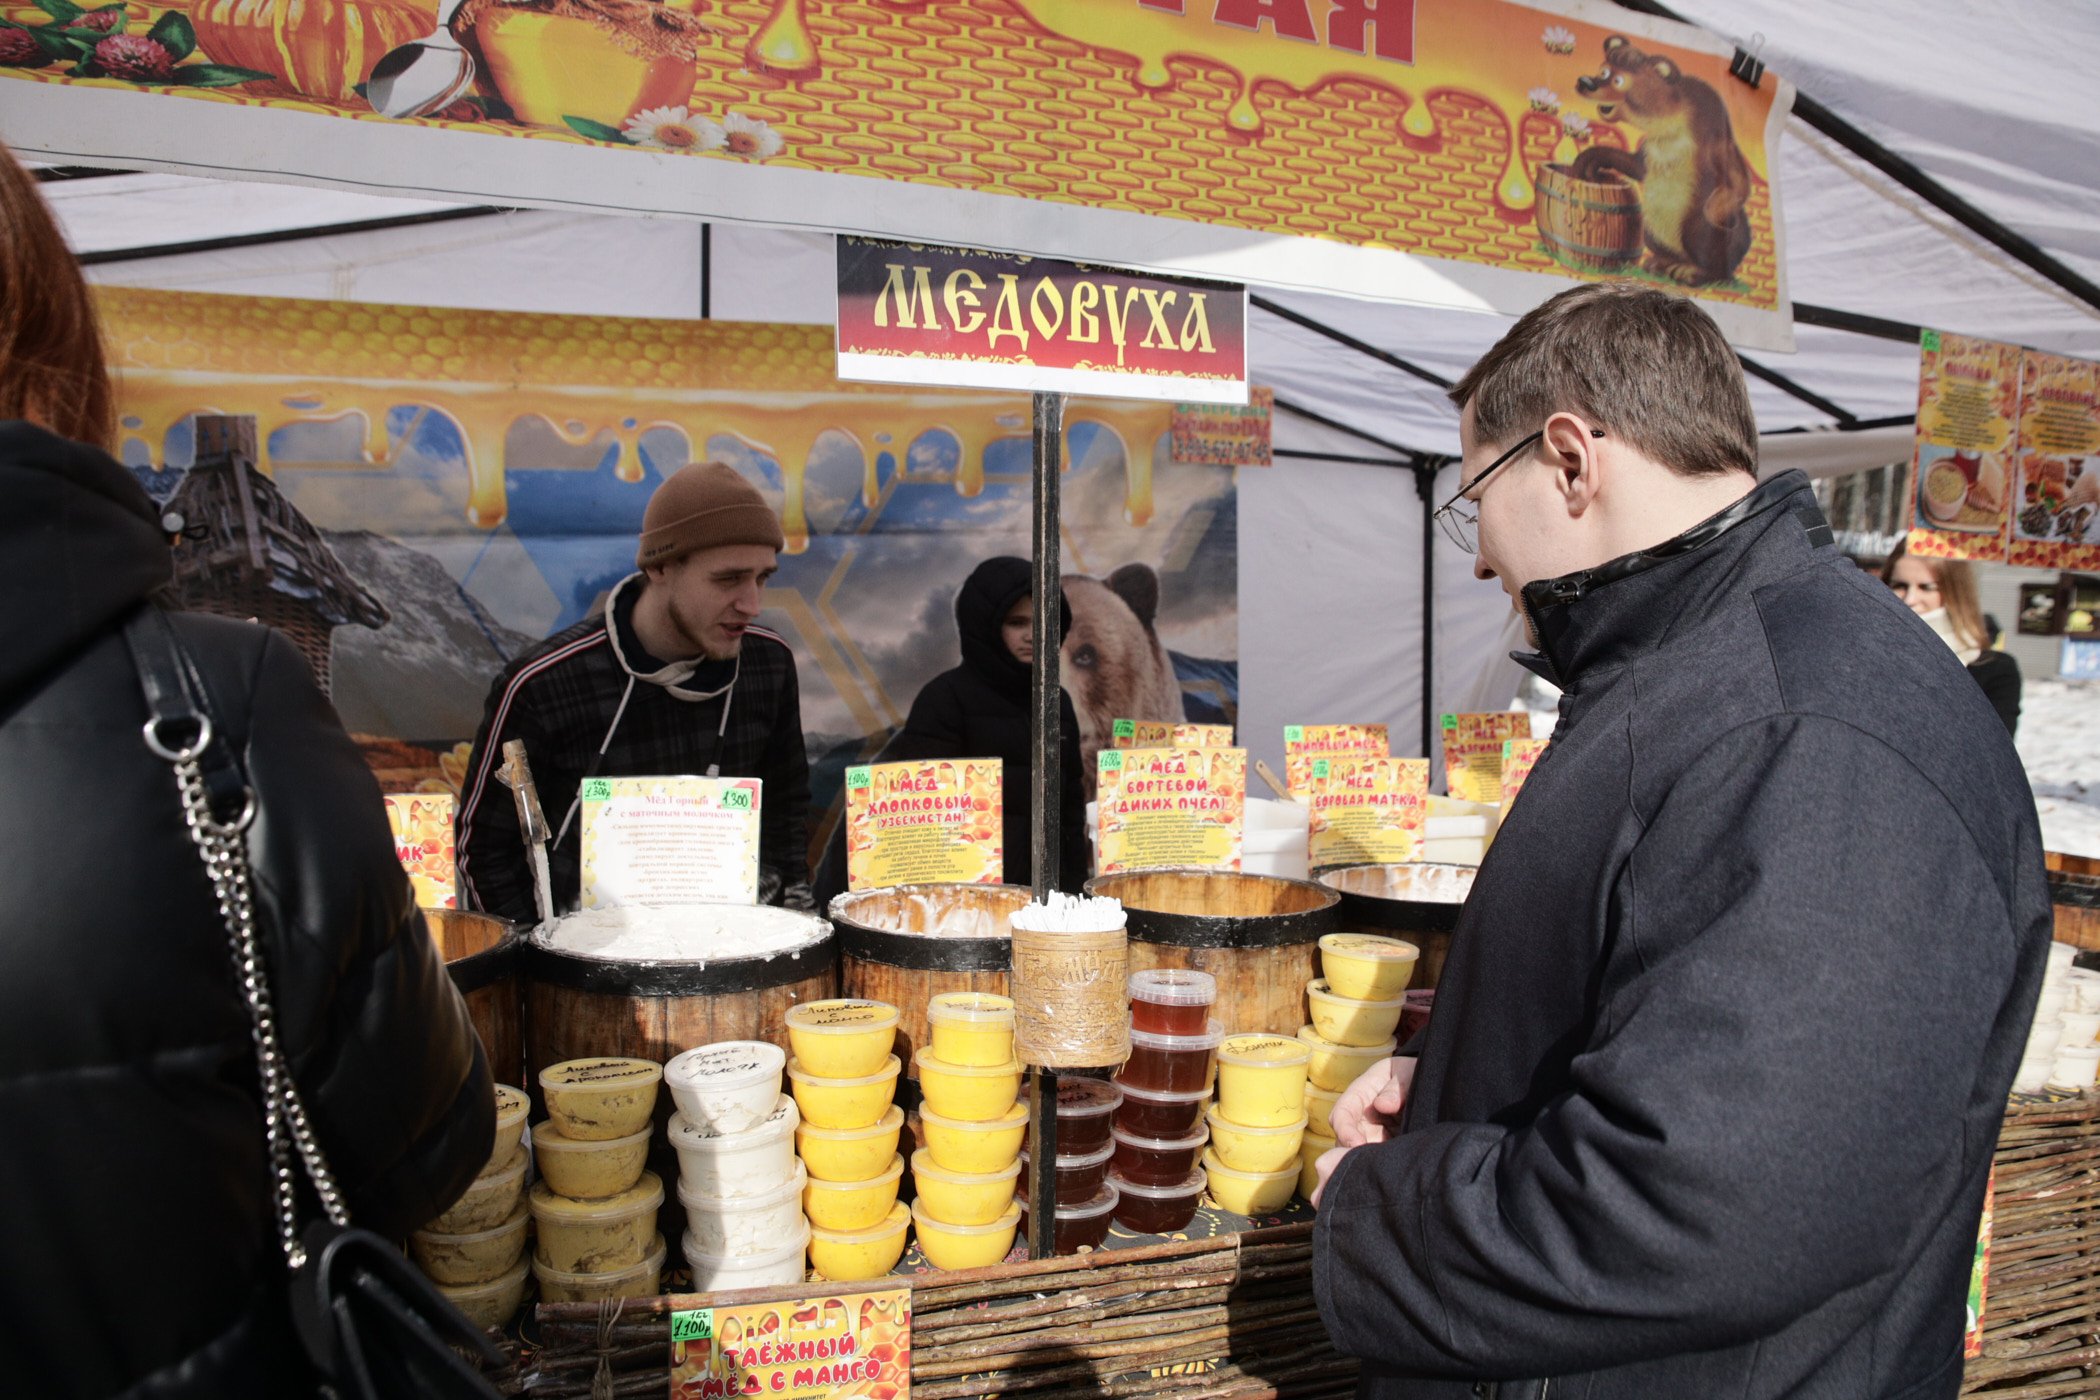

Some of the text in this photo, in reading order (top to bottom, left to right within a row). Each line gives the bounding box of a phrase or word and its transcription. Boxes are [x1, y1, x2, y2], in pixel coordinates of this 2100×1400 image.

[873, 263, 1217, 366] МЕДОВУХА
[1354, 739, 1378, 750] МЕД
[1150, 761, 1186, 774] МЕД
[901, 778, 938, 792] МЕД
[1127, 777, 1208, 794] БОРТЕВОЙ
[1347, 776, 1374, 788] МЕД
[868, 793, 972, 816] ХЛОПКОВЫЙ
[1113, 797, 1226, 814] (ДИКИХ ПЧЕЛ)
[1315, 794, 1418, 807] БОРОВАЯ МАТКА
[684, 810, 733, 818] молочком
[877, 812, 966, 828] (УЗБЕКИСТАН)
[723, 1331, 856, 1371] ТАЁЖНЫЙ
[701, 1358, 882, 1400] МЁД С МАНГО
